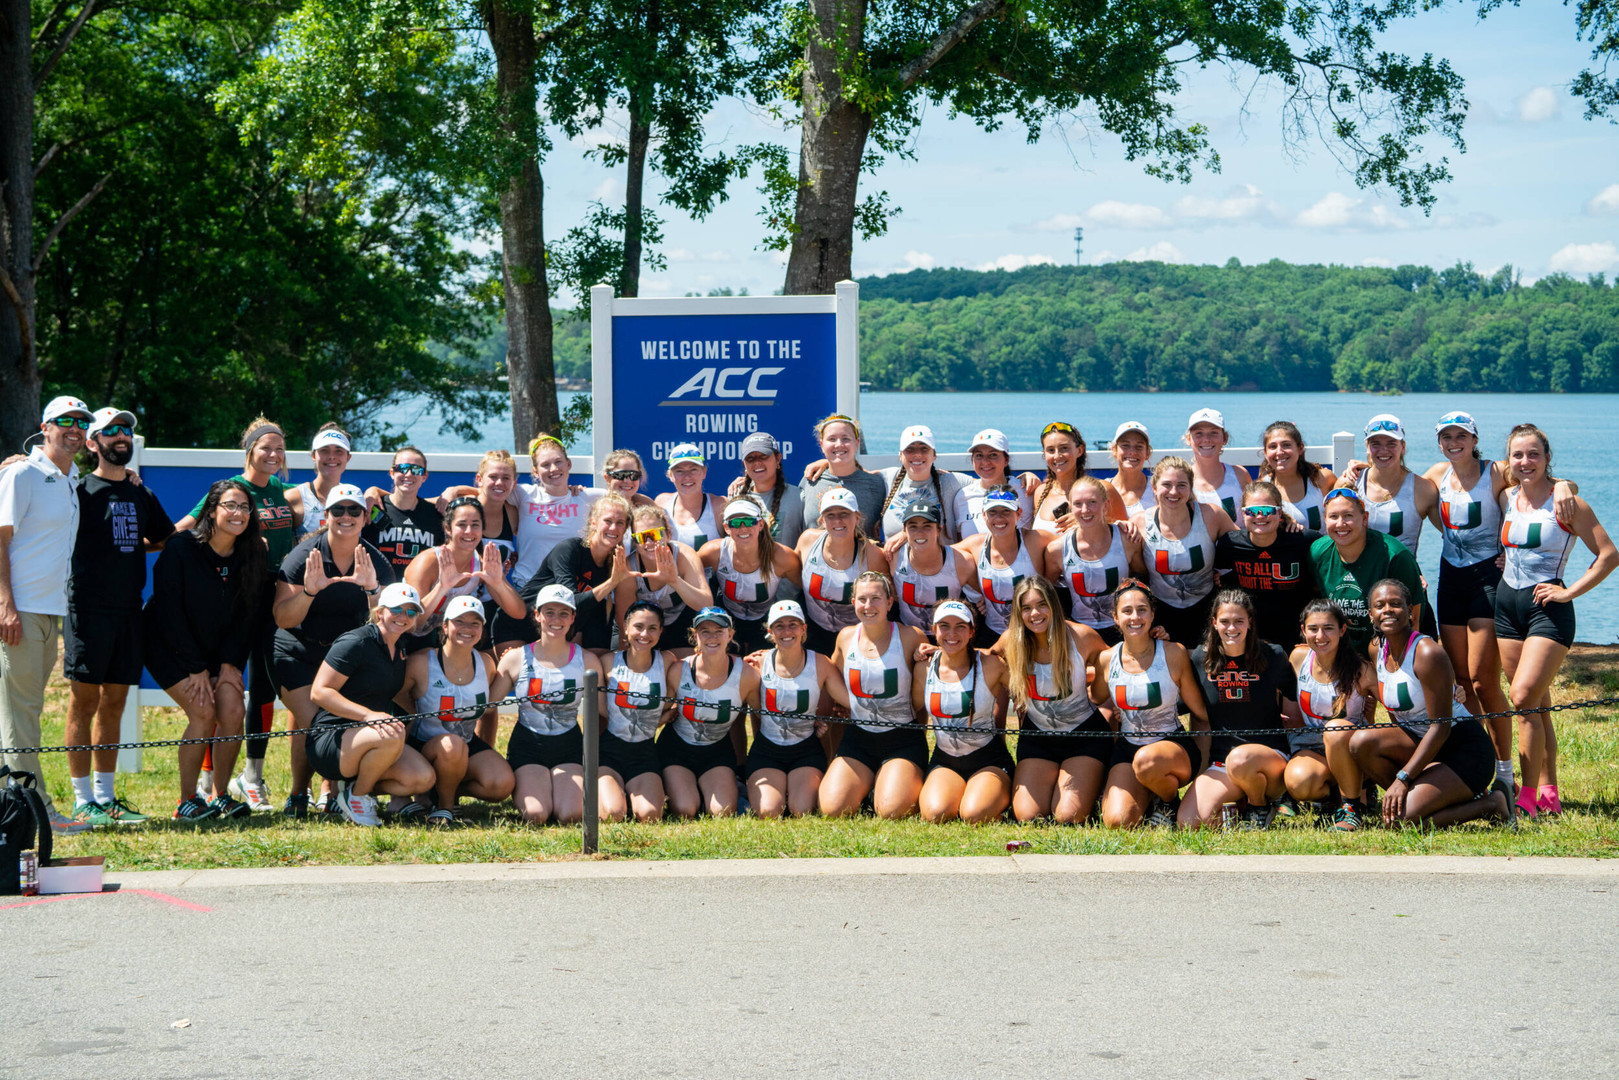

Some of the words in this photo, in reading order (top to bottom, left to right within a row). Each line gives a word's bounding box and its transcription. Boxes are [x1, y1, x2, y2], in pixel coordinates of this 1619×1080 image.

[641, 340, 731, 360] WELCOME
[737, 340, 760, 359] TO
[767, 339, 801, 359] THE
[668, 367, 786, 398] ACC
[686, 413, 758, 433] ROWING
[379, 527, 434, 547] MIAMI
[1235, 561, 1252, 575] IT'S
[1254, 562, 1272, 576] ALL
[1272, 562, 1300, 580] U
[1259, 577, 1273, 590] THE
[1350, 599, 1366, 609] THE
[1226, 688, 1243, 699] U
